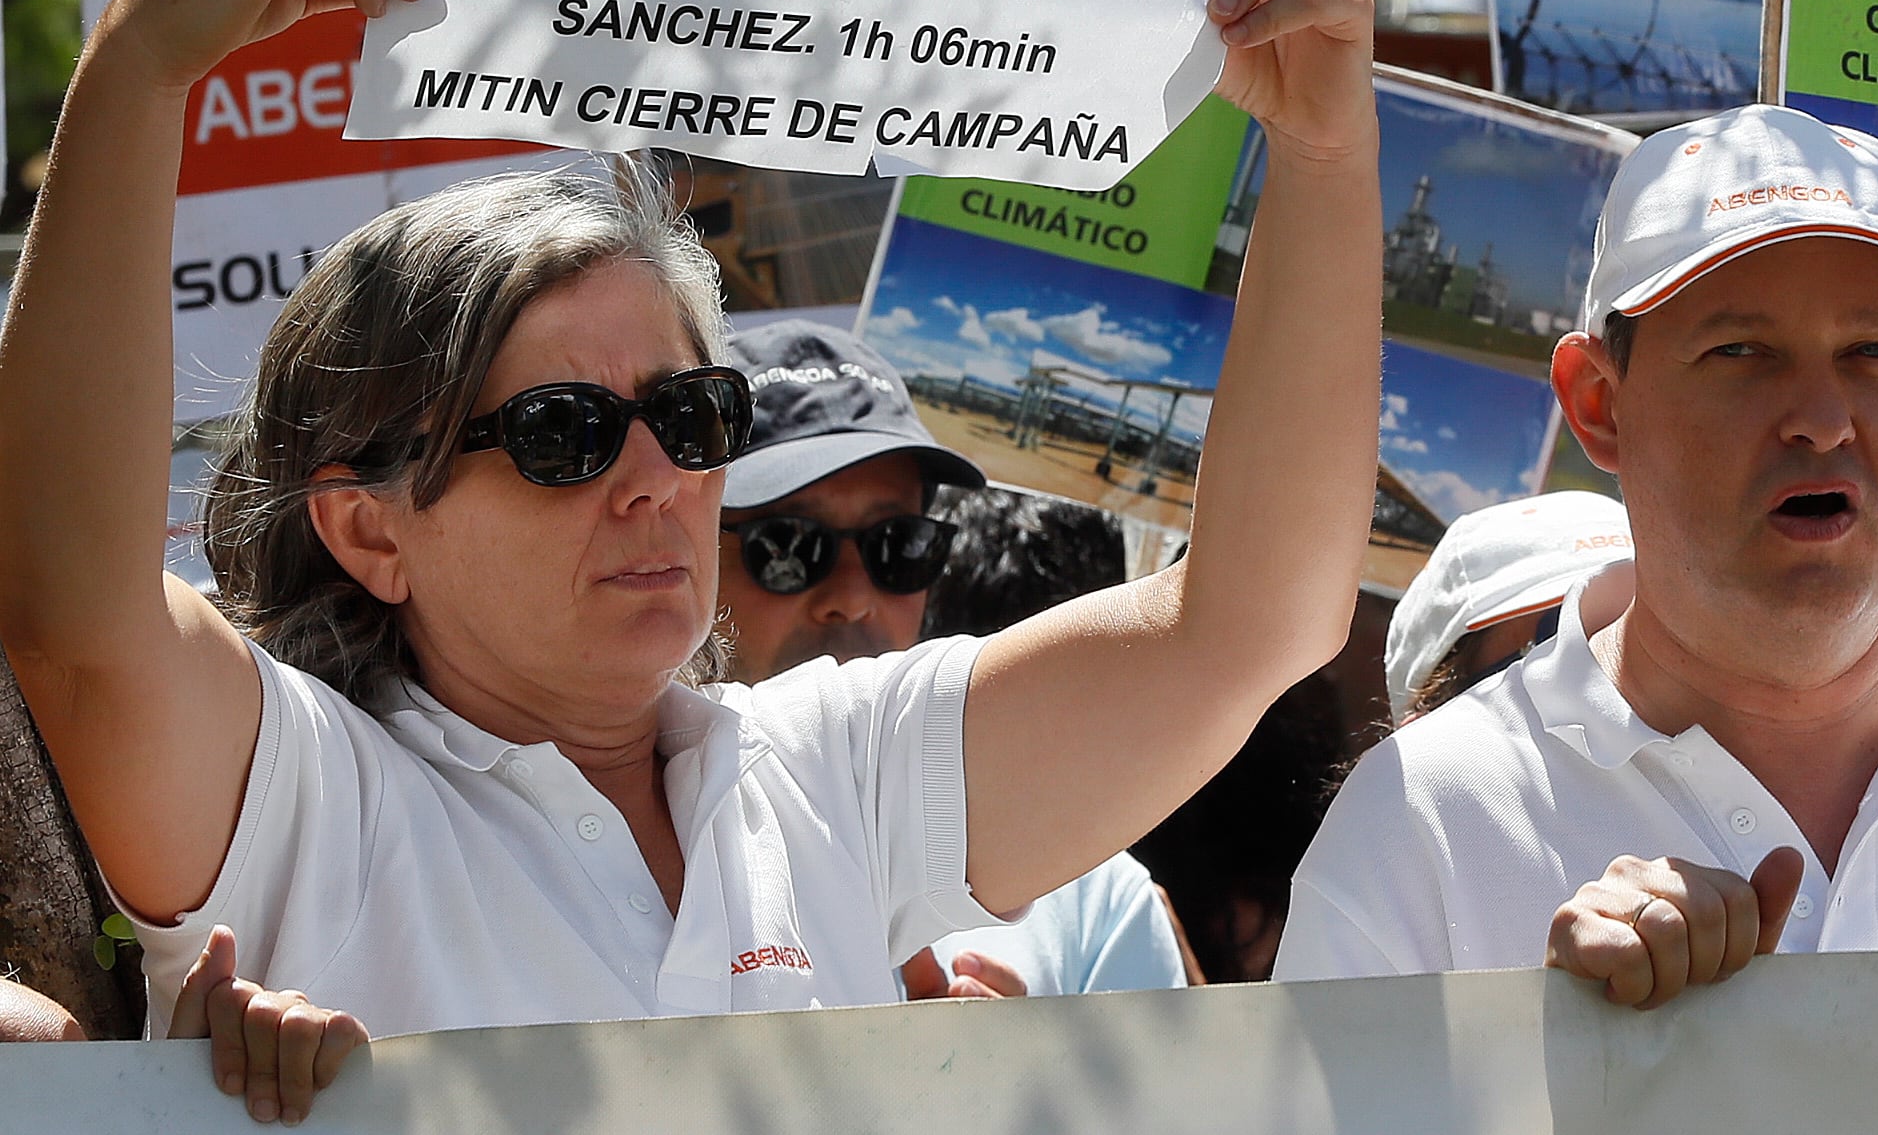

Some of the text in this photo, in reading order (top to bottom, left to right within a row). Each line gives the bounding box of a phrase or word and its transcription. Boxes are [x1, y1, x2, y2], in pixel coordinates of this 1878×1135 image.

[839, 17, 894, 61] 1h
[910, 24, 1056, 74] 06min
[195, 61, 361, 144] ABE
[414, 70, 1130, 164] MITIN CIERRE DE CAMPAÑA
[961, 187, 1149, 255] CLIMÁTICO
[1707, 184, 1855, 216] ABENGOA
[172, 245, 314, 311] SOL
